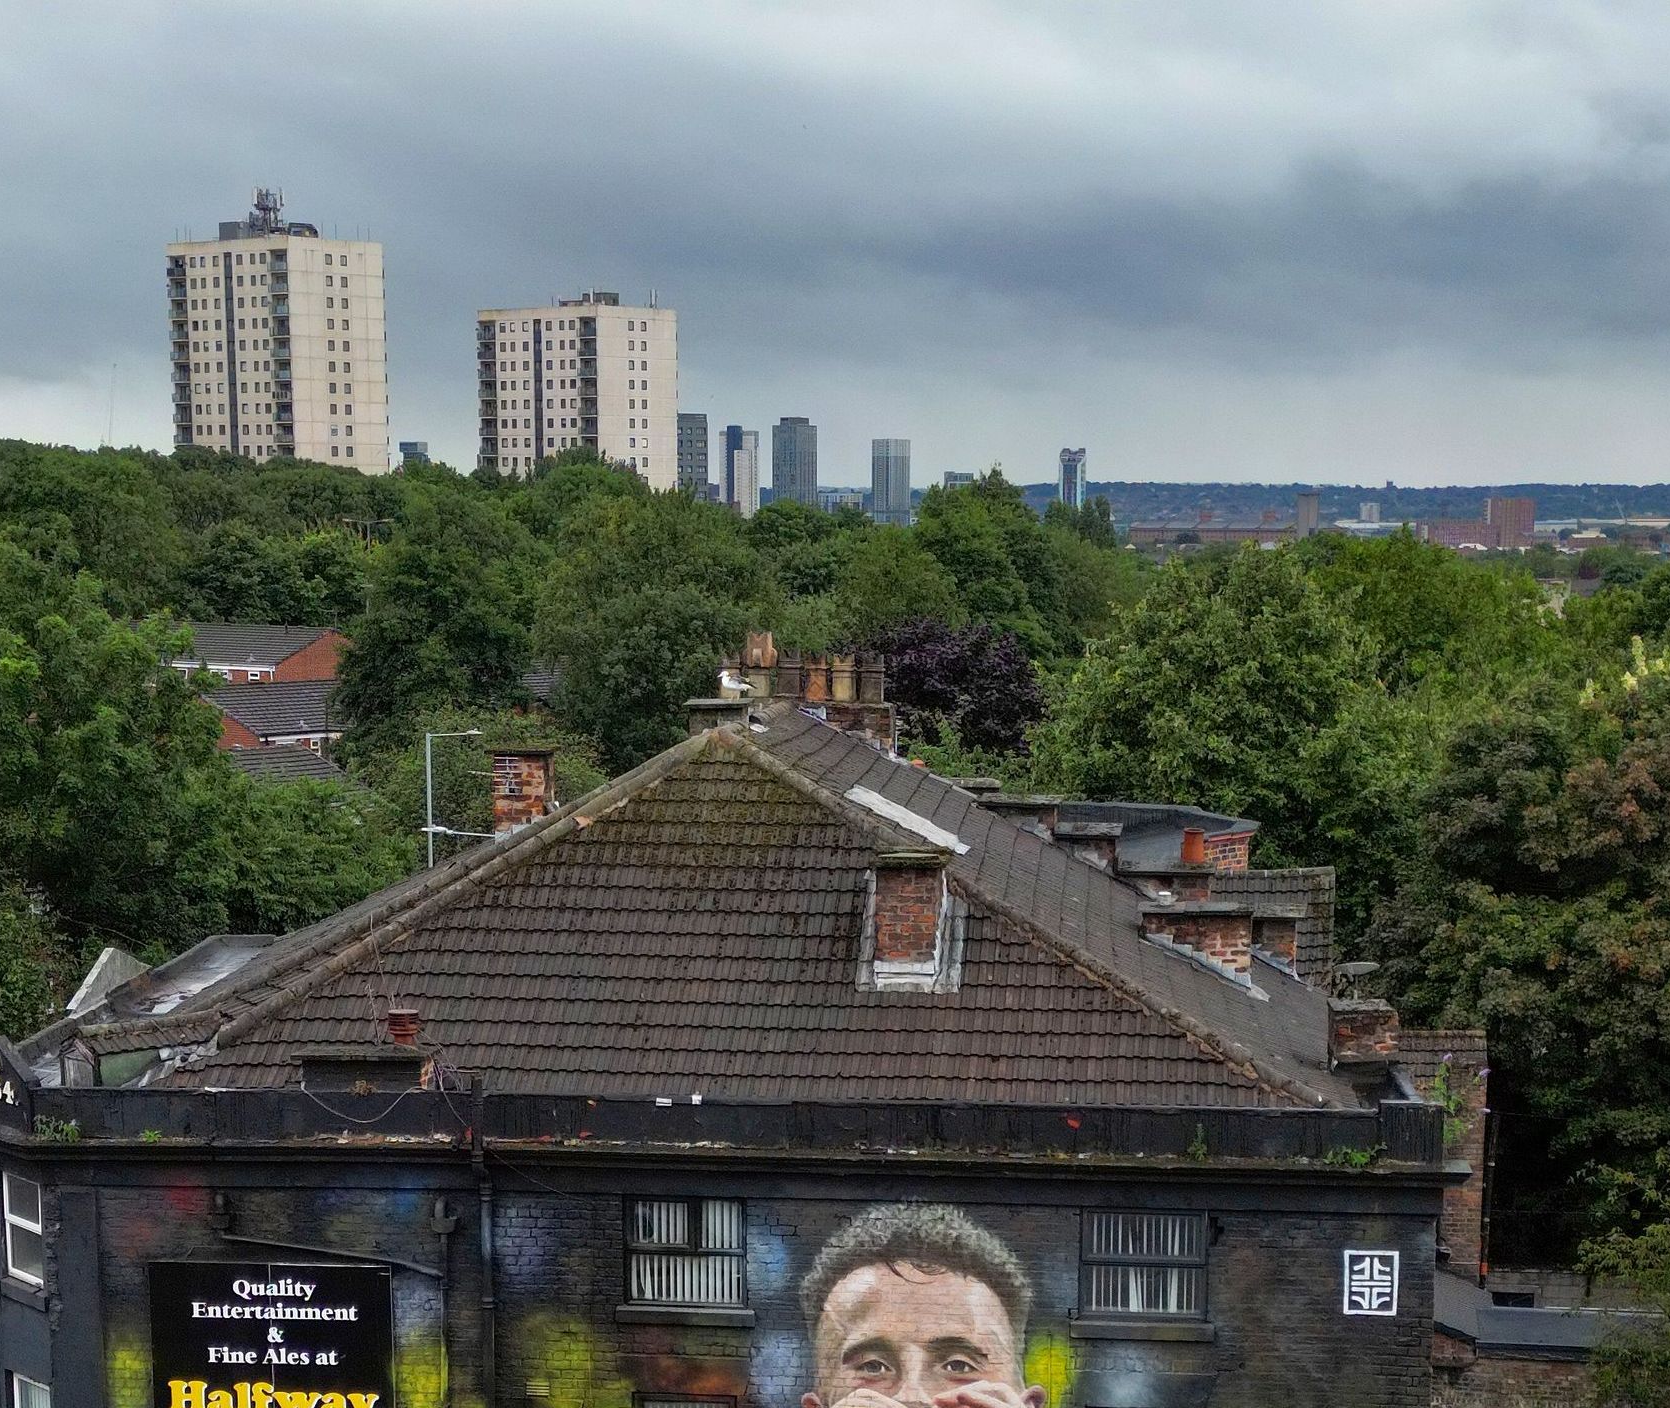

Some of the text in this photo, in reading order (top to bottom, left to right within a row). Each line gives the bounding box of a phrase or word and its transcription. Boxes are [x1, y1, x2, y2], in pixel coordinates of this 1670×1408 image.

[232, 1278, 317, 1301] Quality
[191, 1302, 358, 1321] Entertainment
[267, 1326, 284, 1343] &
[207, 1347, 339, 1366] Fine Ales at
